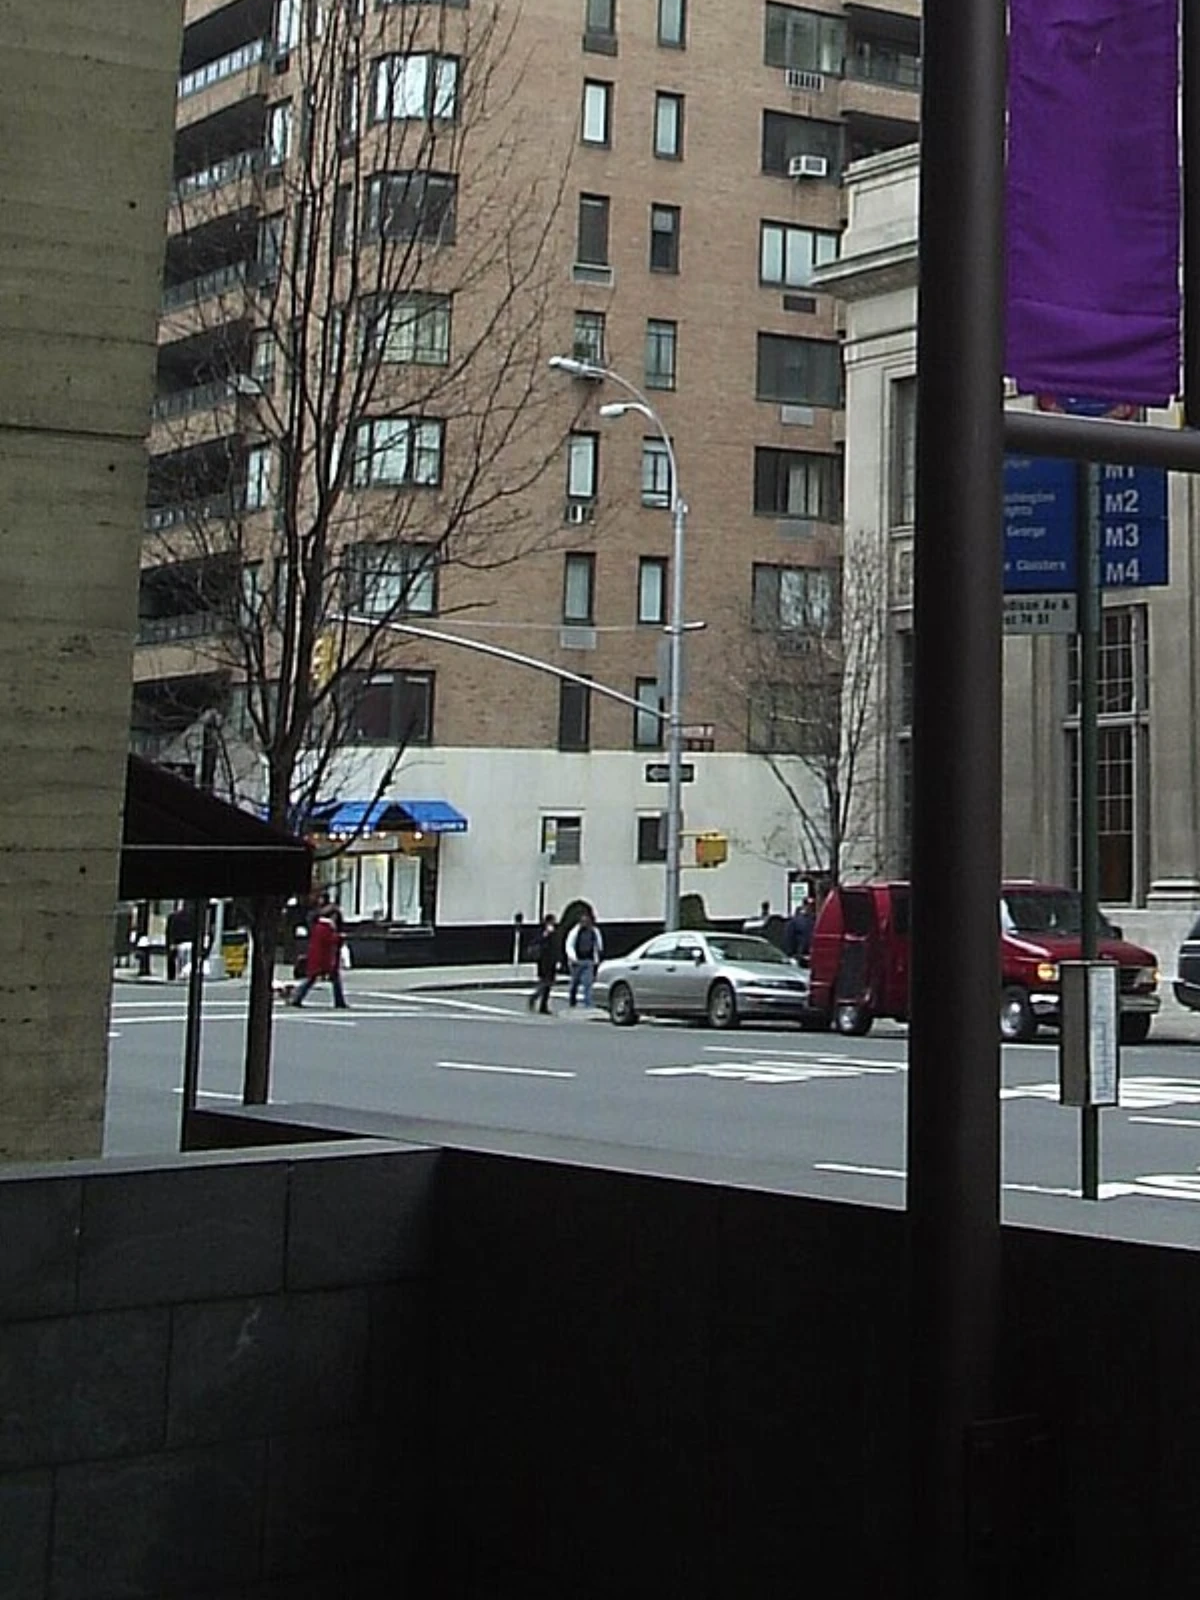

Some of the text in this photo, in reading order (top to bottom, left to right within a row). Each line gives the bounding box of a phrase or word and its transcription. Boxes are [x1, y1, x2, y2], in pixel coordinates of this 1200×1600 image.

[1105, 489, 1139, 513] M2
[1105, 523, 1139, 547] M3
[1105, 558, 1139, 582] M4
